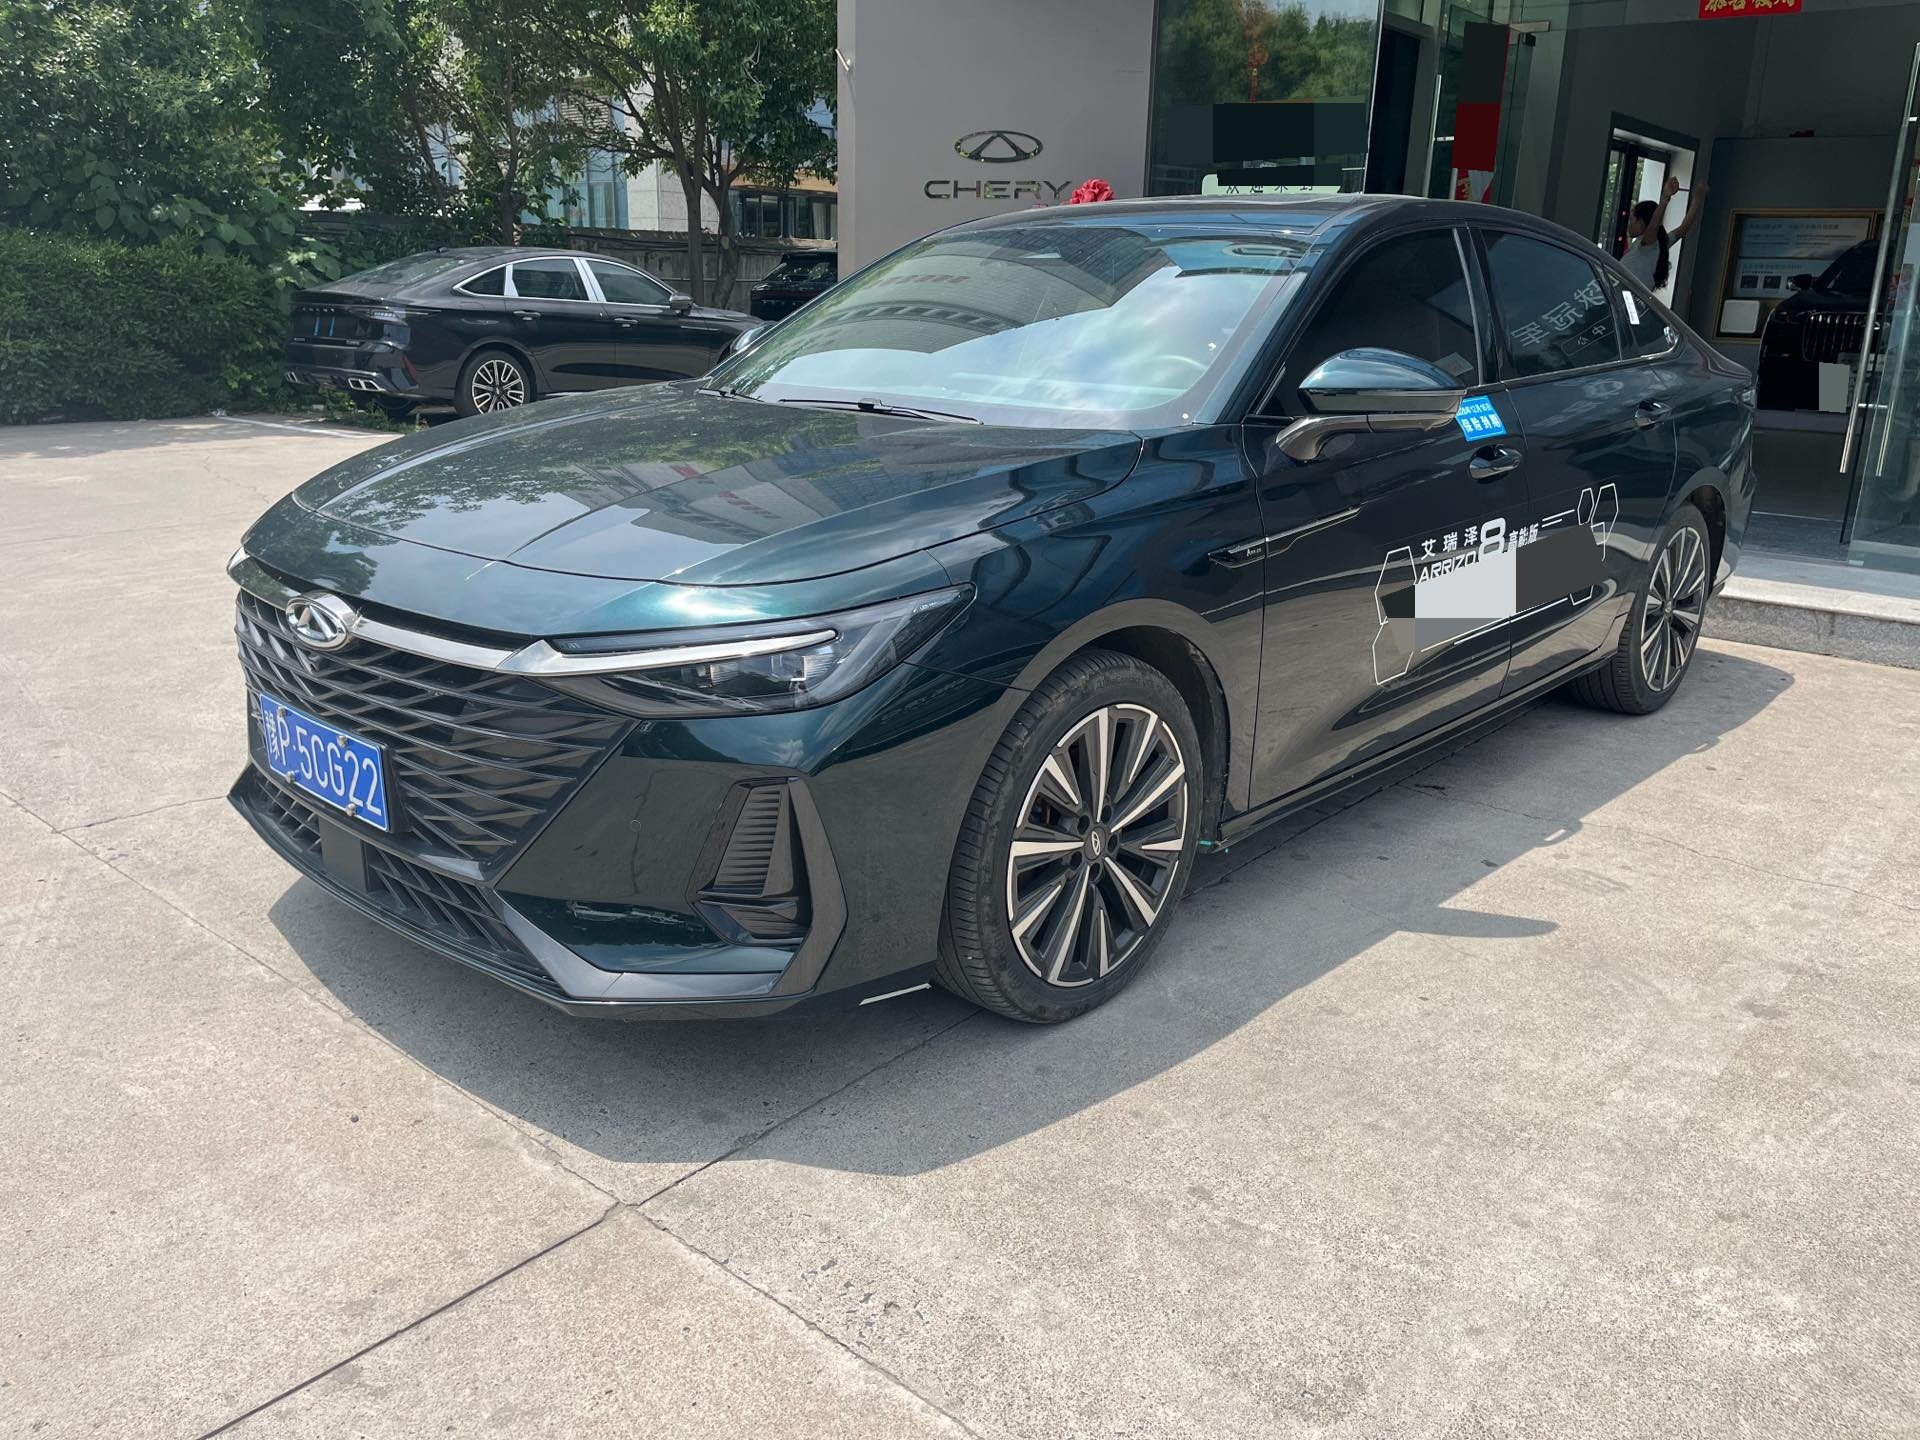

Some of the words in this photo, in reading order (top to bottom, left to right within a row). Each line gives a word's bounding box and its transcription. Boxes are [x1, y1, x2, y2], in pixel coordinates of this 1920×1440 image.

[923, 180, 1072, 199] CHERY
[1460, 413, 1502, 433] 保险到期
[1418, 550, 1477, 584] ARRIZO
